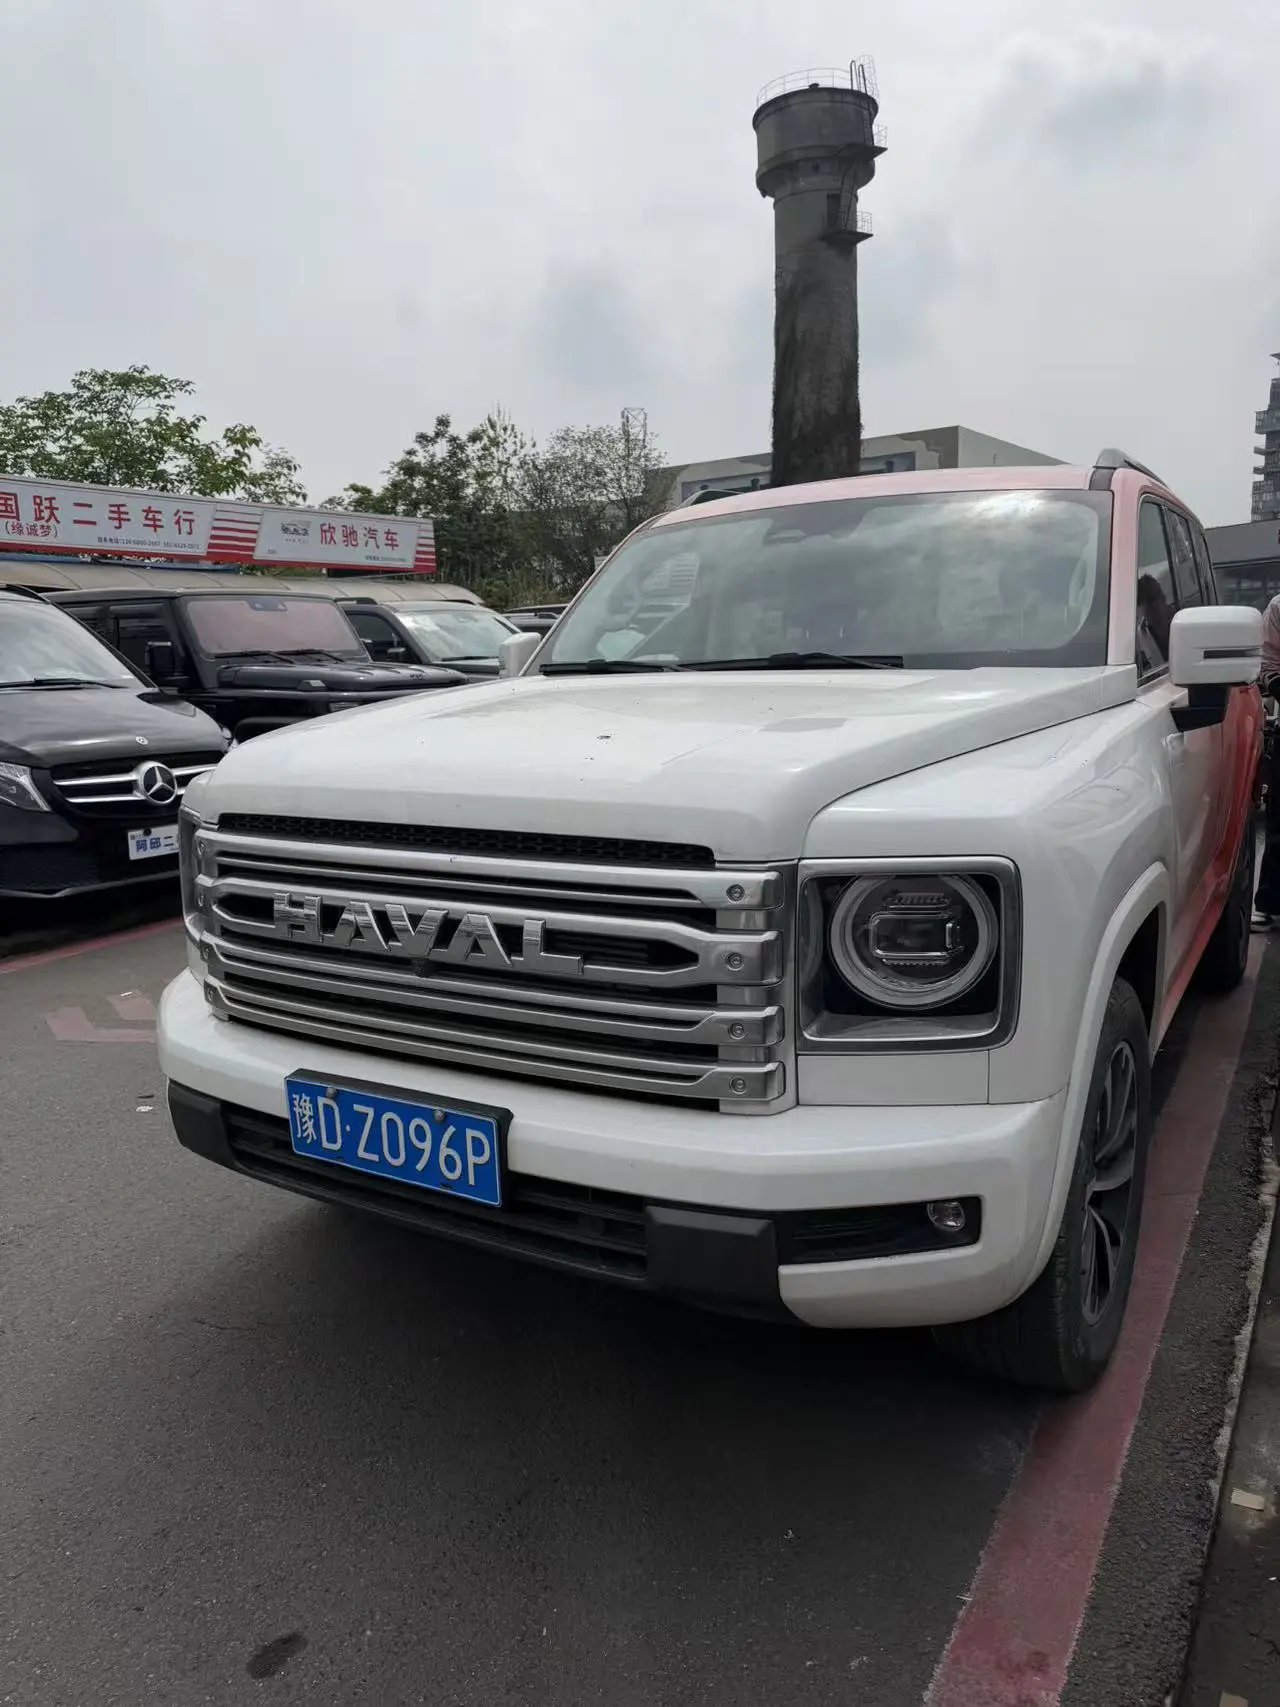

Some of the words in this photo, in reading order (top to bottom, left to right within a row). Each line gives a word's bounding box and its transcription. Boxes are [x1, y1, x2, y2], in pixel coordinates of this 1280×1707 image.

[0, 492, 195, 535] 国跃二手车行
[319, 523, 399, 550] 欣驰汽车
[273, 892, 583, 976] HAVAL
